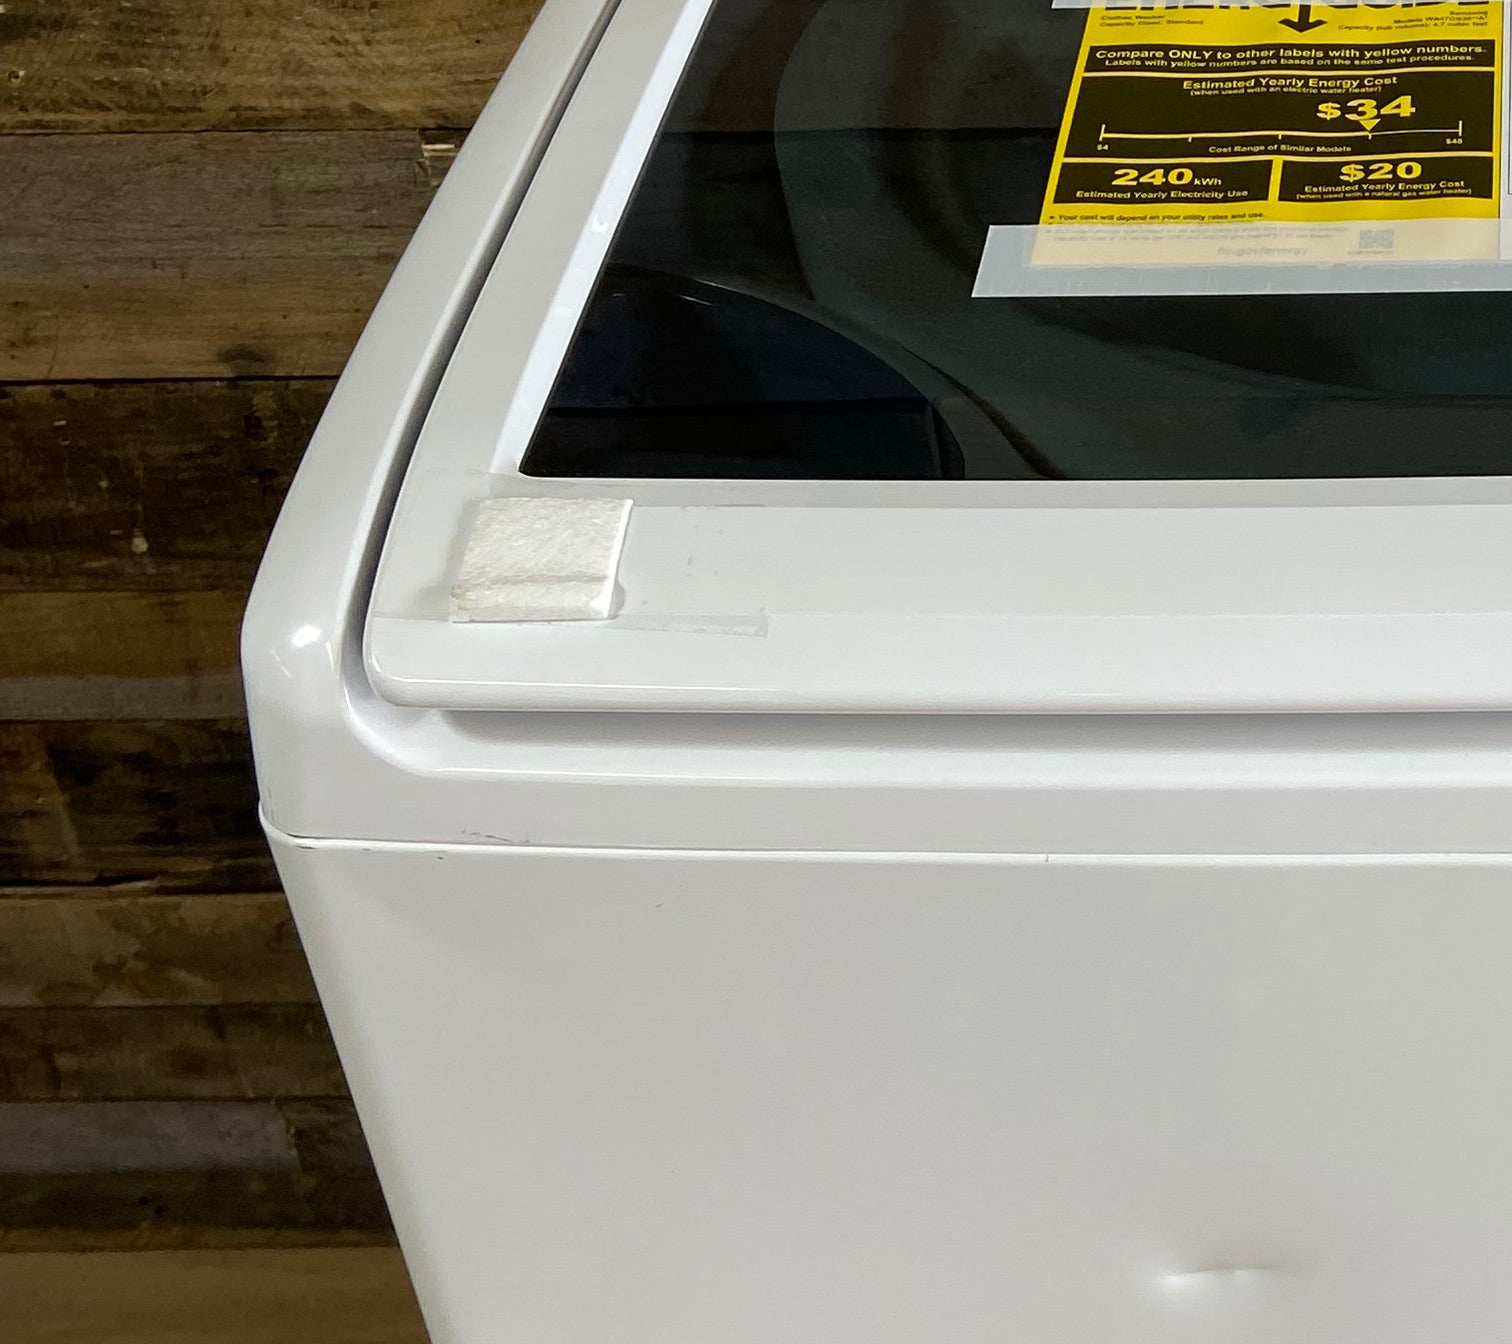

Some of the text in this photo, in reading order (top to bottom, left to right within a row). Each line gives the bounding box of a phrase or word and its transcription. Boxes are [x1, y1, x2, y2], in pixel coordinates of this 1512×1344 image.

[1096, 45, 1486, 60] Compare ONLY to other labels with yellow numbers.
[1171, 60, 1206, 68] yellow
[1209, 59, 1257, 67] numbers
[1386, 56, 1407, 64] test
[1410, 54, 1474, 62] procedures.
[1183, 76, 1397, 89] Estimated Yearly Energy Cost
[1190, 89, 1219, 97] (when
[1317, 95, 1416, 120] $34
[1209, 145, 1231, 154] Cost
[1233, 145, 1265, 153] Range
[1280, 144, 1314, 152] Similar
[1111, 167, 1194, 187] 240
[1339, 161, 1423, 184] $20
[1194, 177, 1222, 186] kWh
[1304, 180, 1465, 192] Estimated Yearly Energy Cost
[1076, 189, 1249, 200] Estimated Yearly Electricity Use
